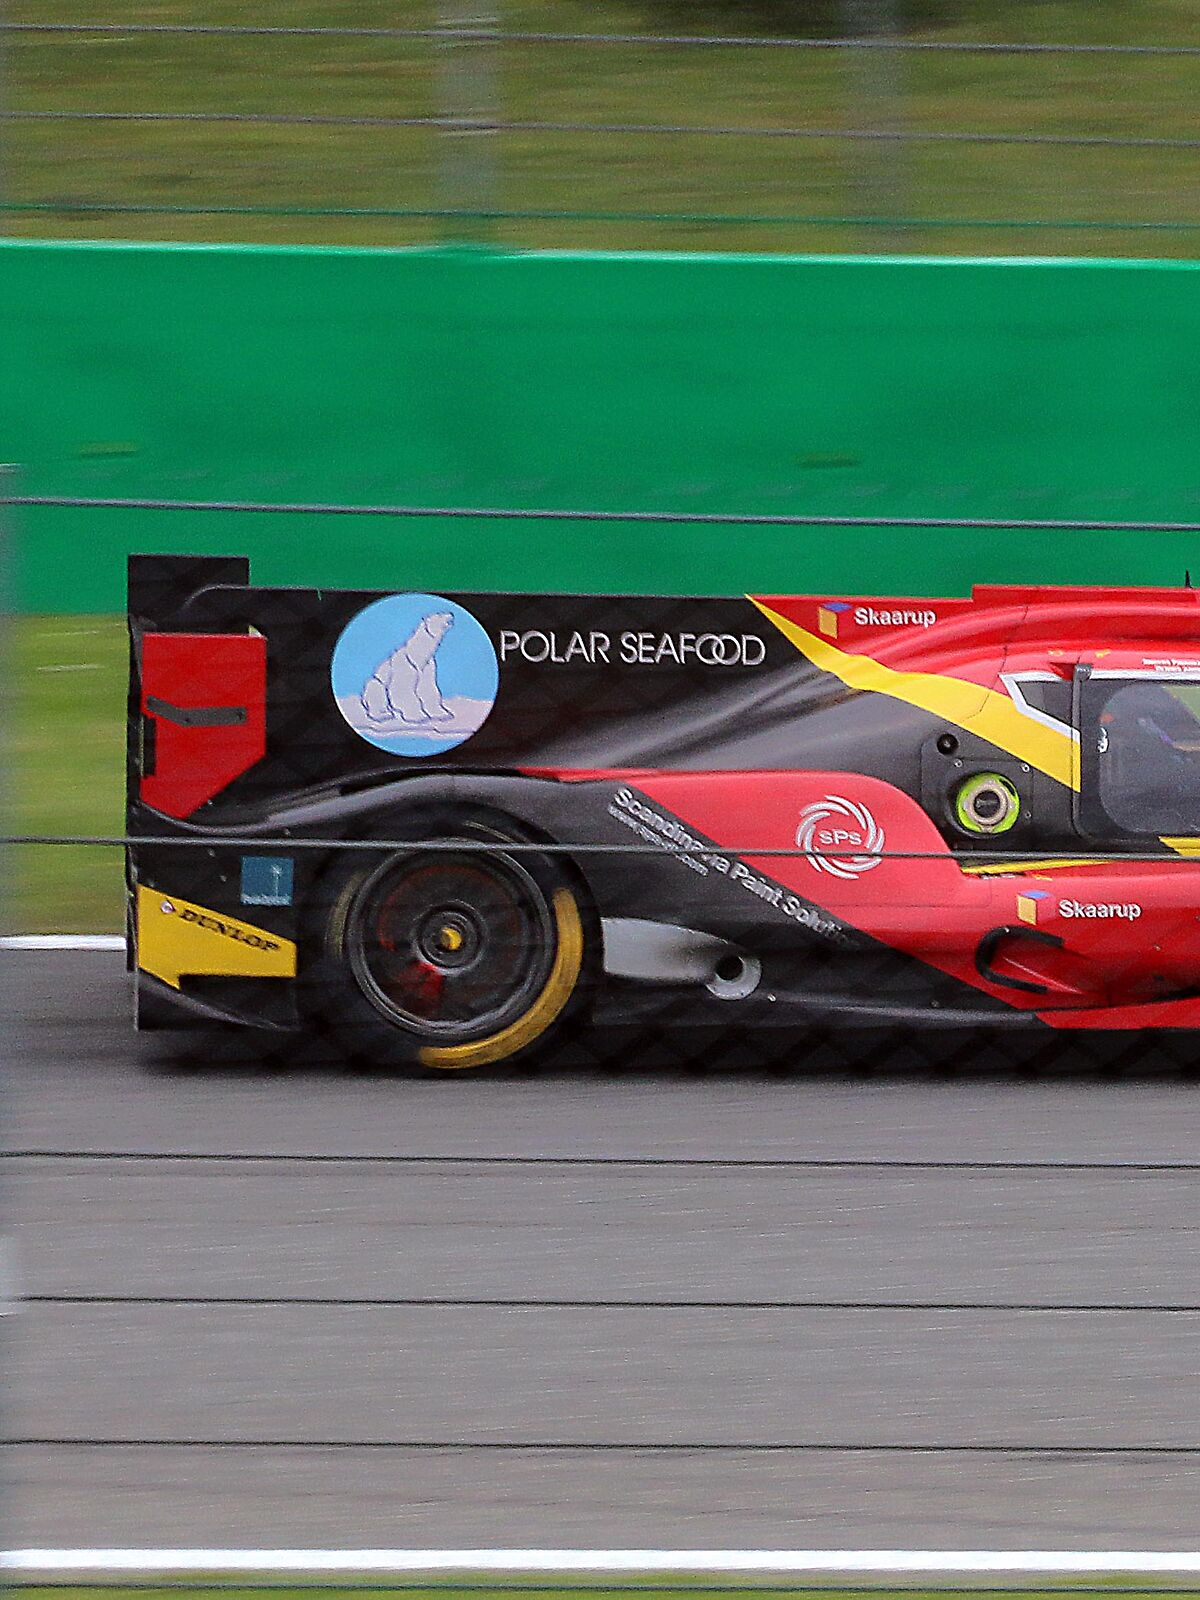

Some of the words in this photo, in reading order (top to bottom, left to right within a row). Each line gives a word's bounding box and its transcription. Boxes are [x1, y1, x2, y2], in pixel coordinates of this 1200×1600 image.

[854, 607, 937, 629] Skaarup
[500, 630, 611, 664] POLAR
[619, 631, 767, 666] SEAFOOD
[818, 828, 862, 846] SPS
[730, 862, 783, 908] Paint
[1059, 899, 1142, 921] Skaarup
[179, 908, 281, 952] DUNLOP
